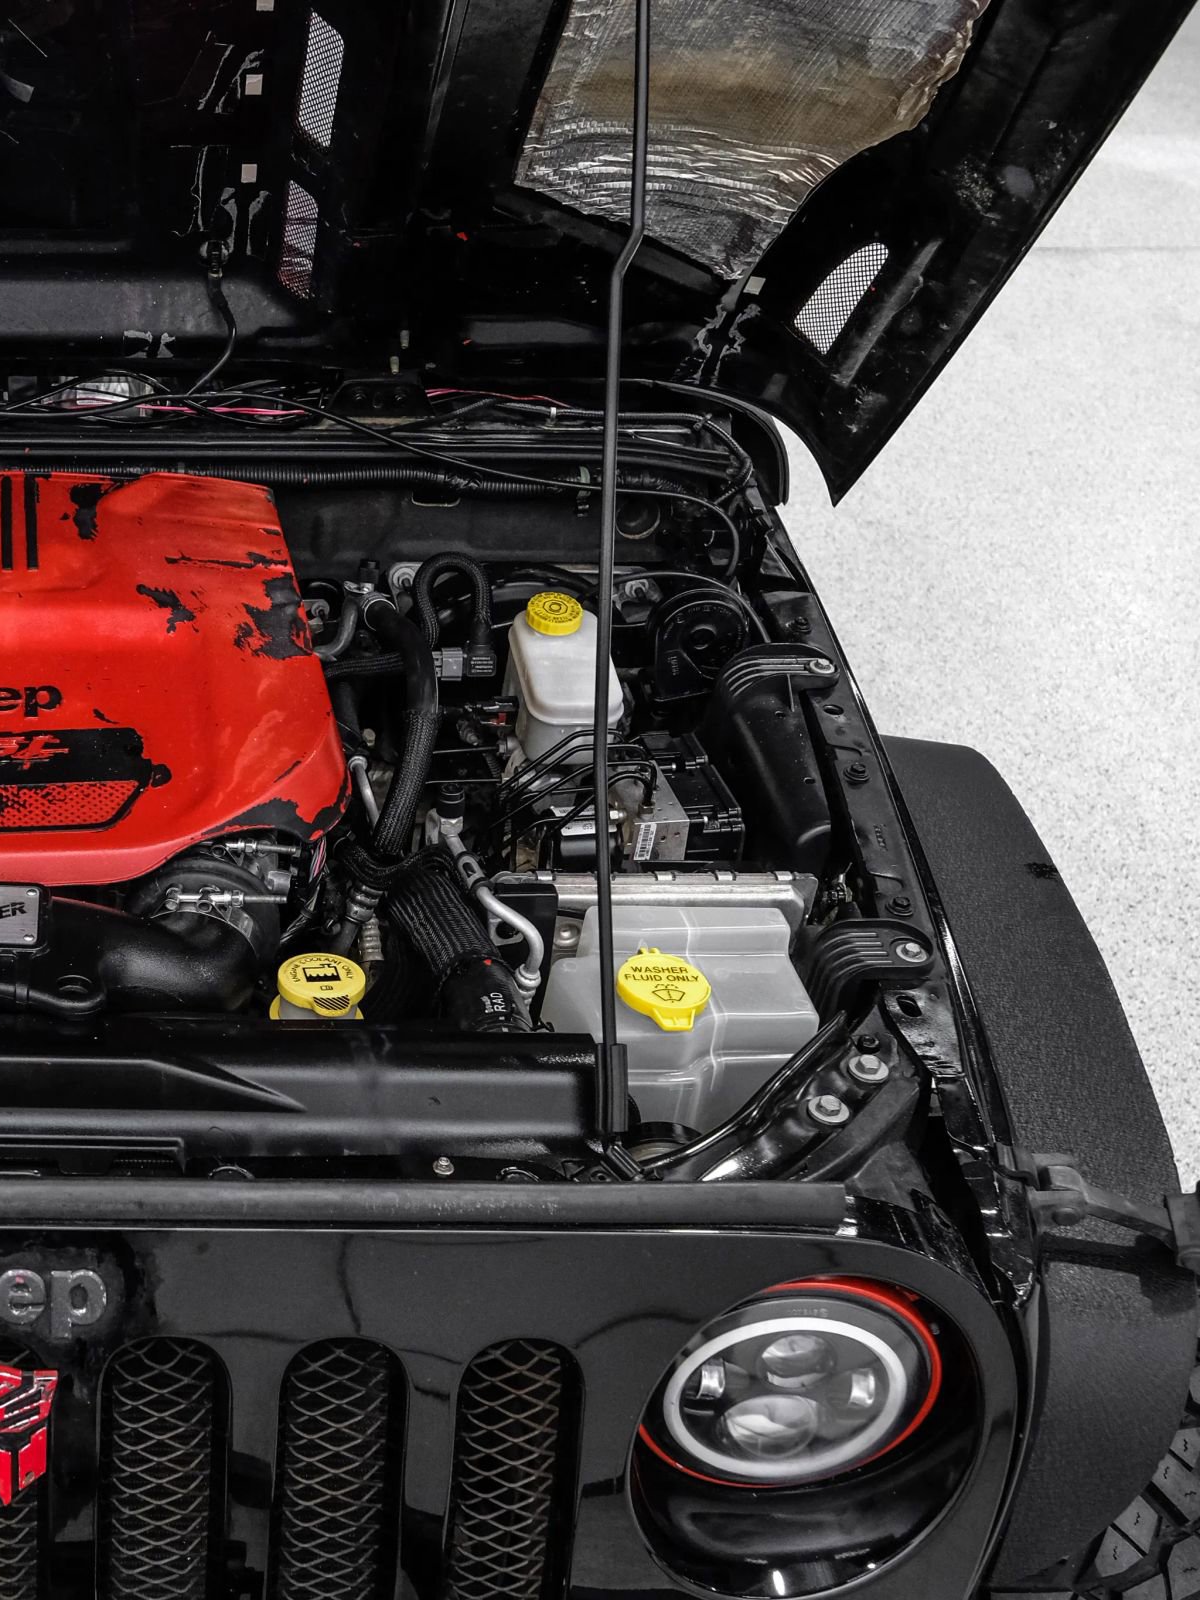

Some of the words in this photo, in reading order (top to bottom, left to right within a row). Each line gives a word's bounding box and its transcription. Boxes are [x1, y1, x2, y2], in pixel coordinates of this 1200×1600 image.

[300, 957, 342, 966] COOLANT
[341, 962, 354, 980] ONLY
[630, 966, 688, 974] WASHER
[624, 973, 662, 982] FLUID
[666, 974, 699, 982] ONLY
[490, 992, 507, 1012] RAD
